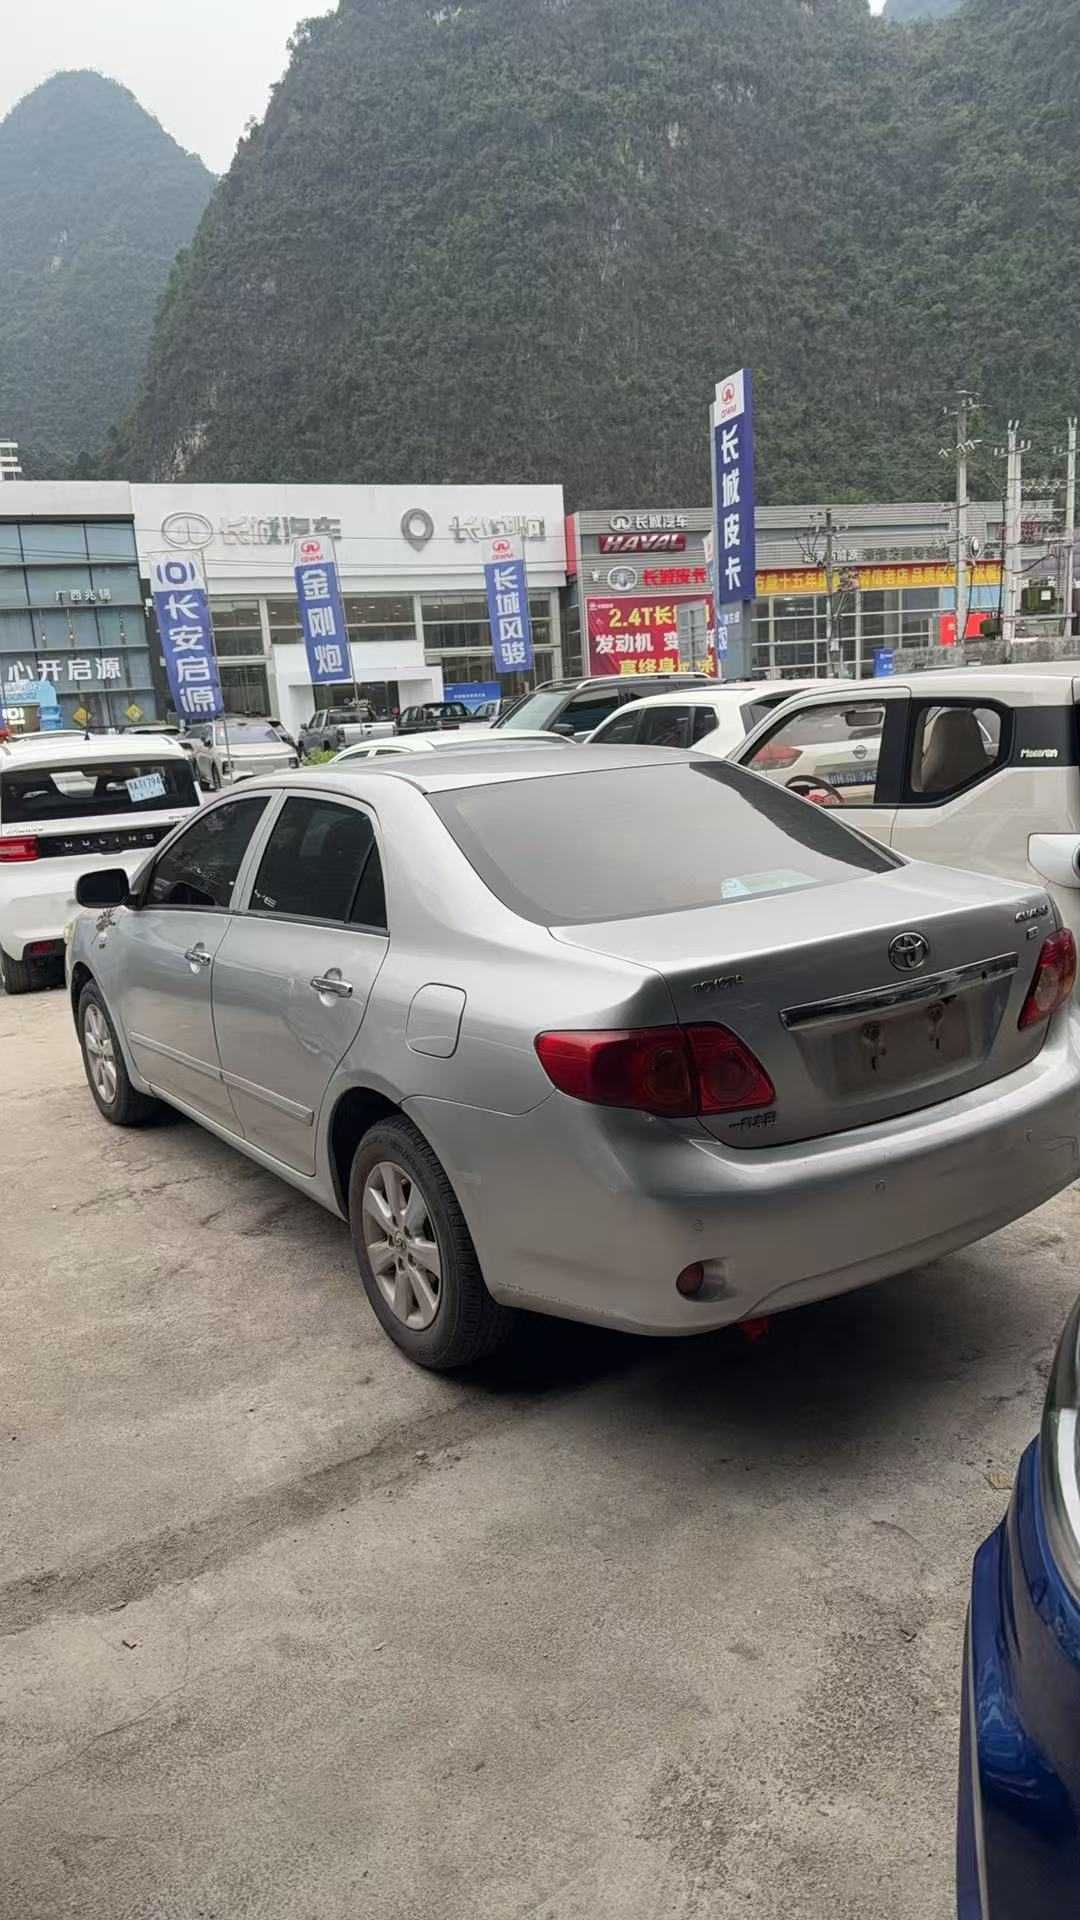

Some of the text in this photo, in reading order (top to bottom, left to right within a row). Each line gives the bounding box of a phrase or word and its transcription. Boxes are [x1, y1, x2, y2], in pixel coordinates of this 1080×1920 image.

[635, 513, 689, 530] 长城汽车
[721, 424, 741, 591] 长城皮卡
[603, 534, 684, 551] HAVAL
[301, 568, 343, 674] 金刚炮
[494, 565, 527, 665] 长城风骏
[595, 632, 654, 654] 发动机
[8, 656, 121, 682] 心开启源
[164, 594, 215, 713] 长安启源
